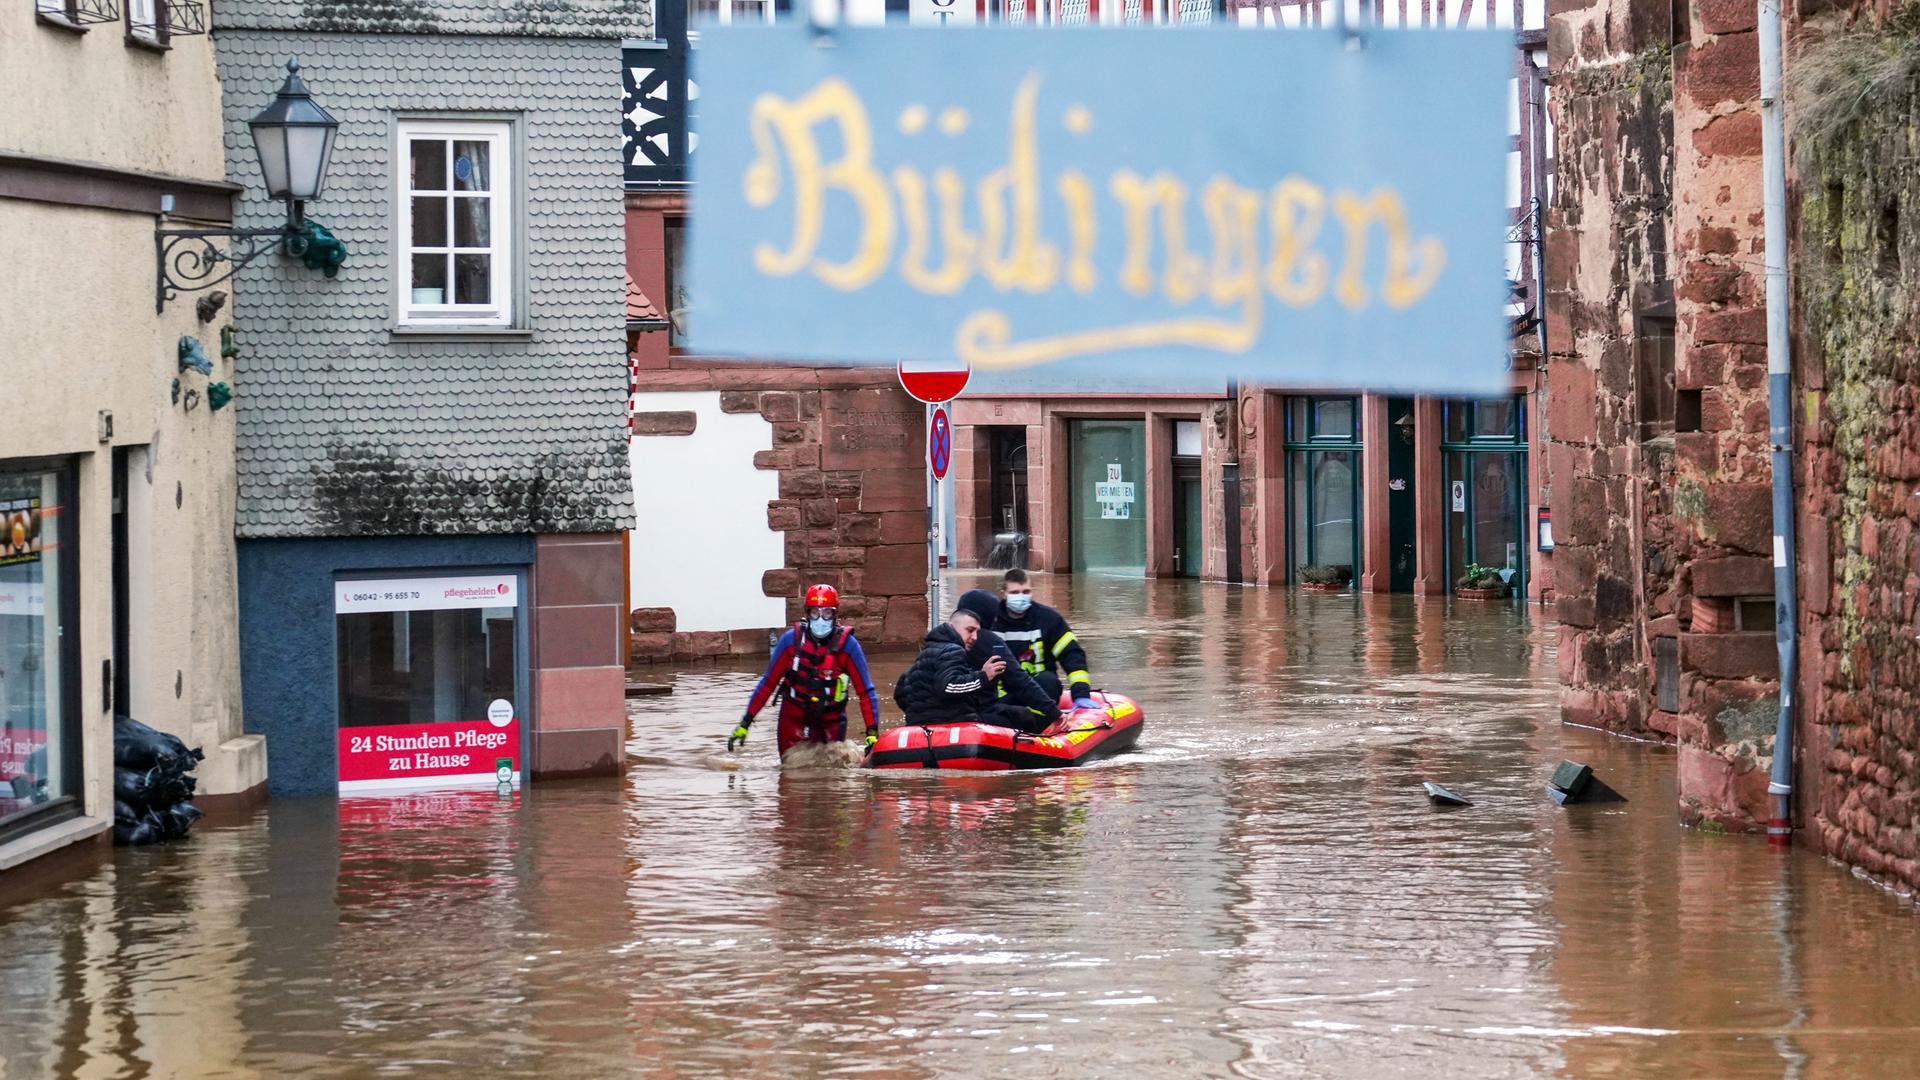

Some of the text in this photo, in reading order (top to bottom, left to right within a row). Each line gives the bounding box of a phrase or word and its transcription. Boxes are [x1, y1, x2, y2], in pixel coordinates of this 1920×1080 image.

[742, 72, 1447, 371] Büdingen
[1109, 467, 1120, 480] ZU
[353, 593, 378, 601] 06042
[384, 592, 394, 600] 95
[395, 591, 409, 600] 655
[411, 591, 421, 599] 70
[444, 587, 497, 598] pflegehelden
[350, 729, 507, 753] 24 Stunden Pflege
[389, 753, 470, 771] zu Hause
